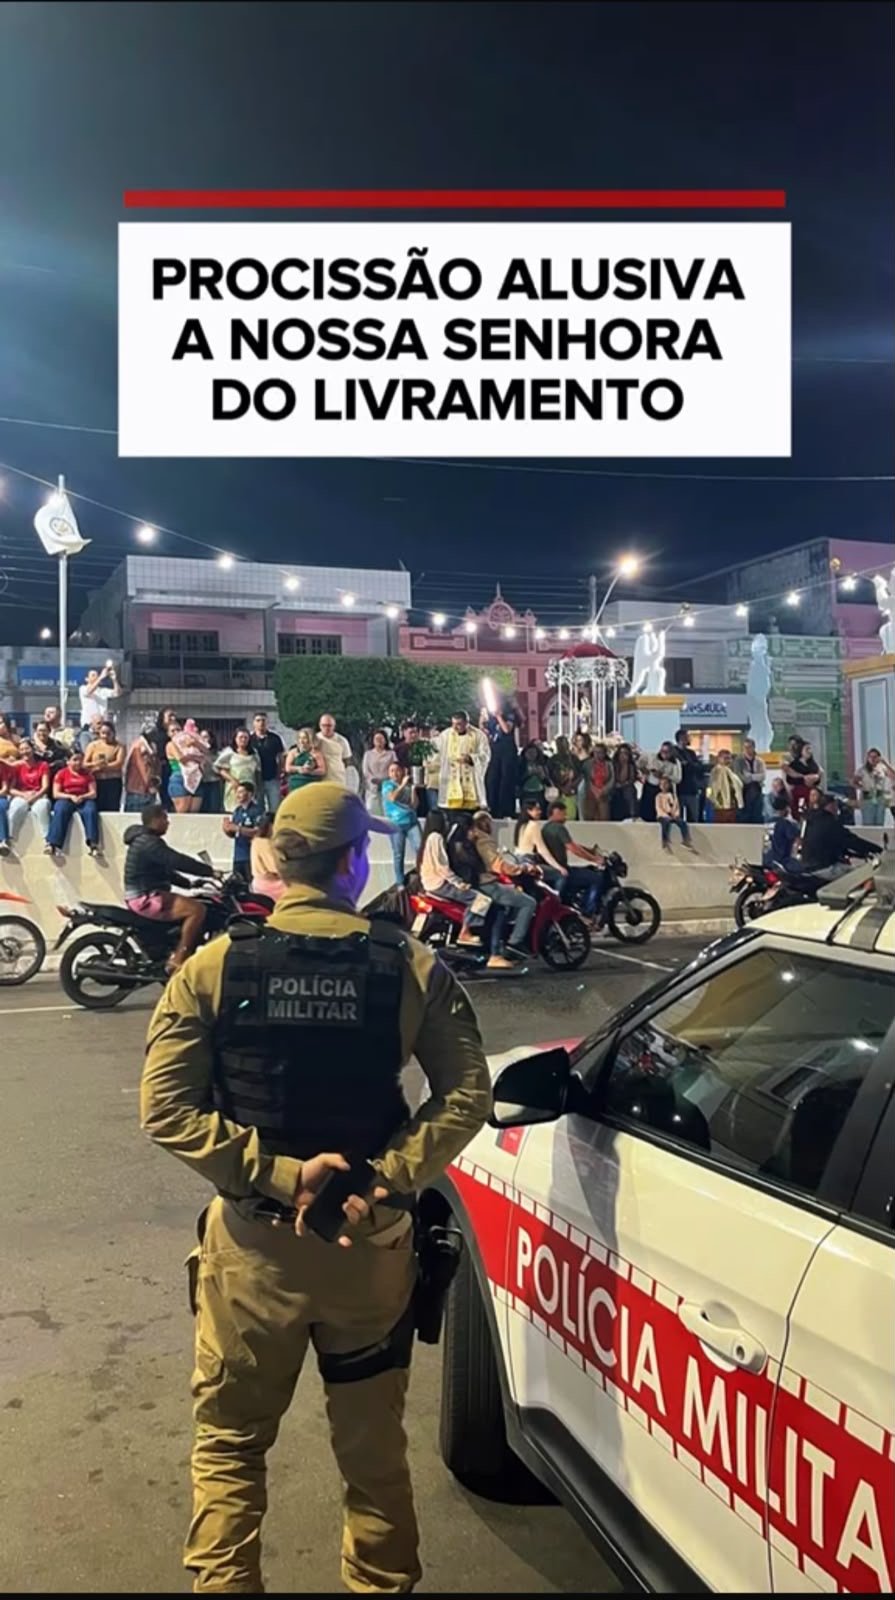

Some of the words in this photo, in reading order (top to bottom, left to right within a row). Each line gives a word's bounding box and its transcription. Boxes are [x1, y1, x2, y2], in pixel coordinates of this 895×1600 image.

[268, 974, 358, 998] POLÍCIA
[267, 999, 358, 1020] MILITAR
[516, 1226, 667, 1417] POLÍCIA
